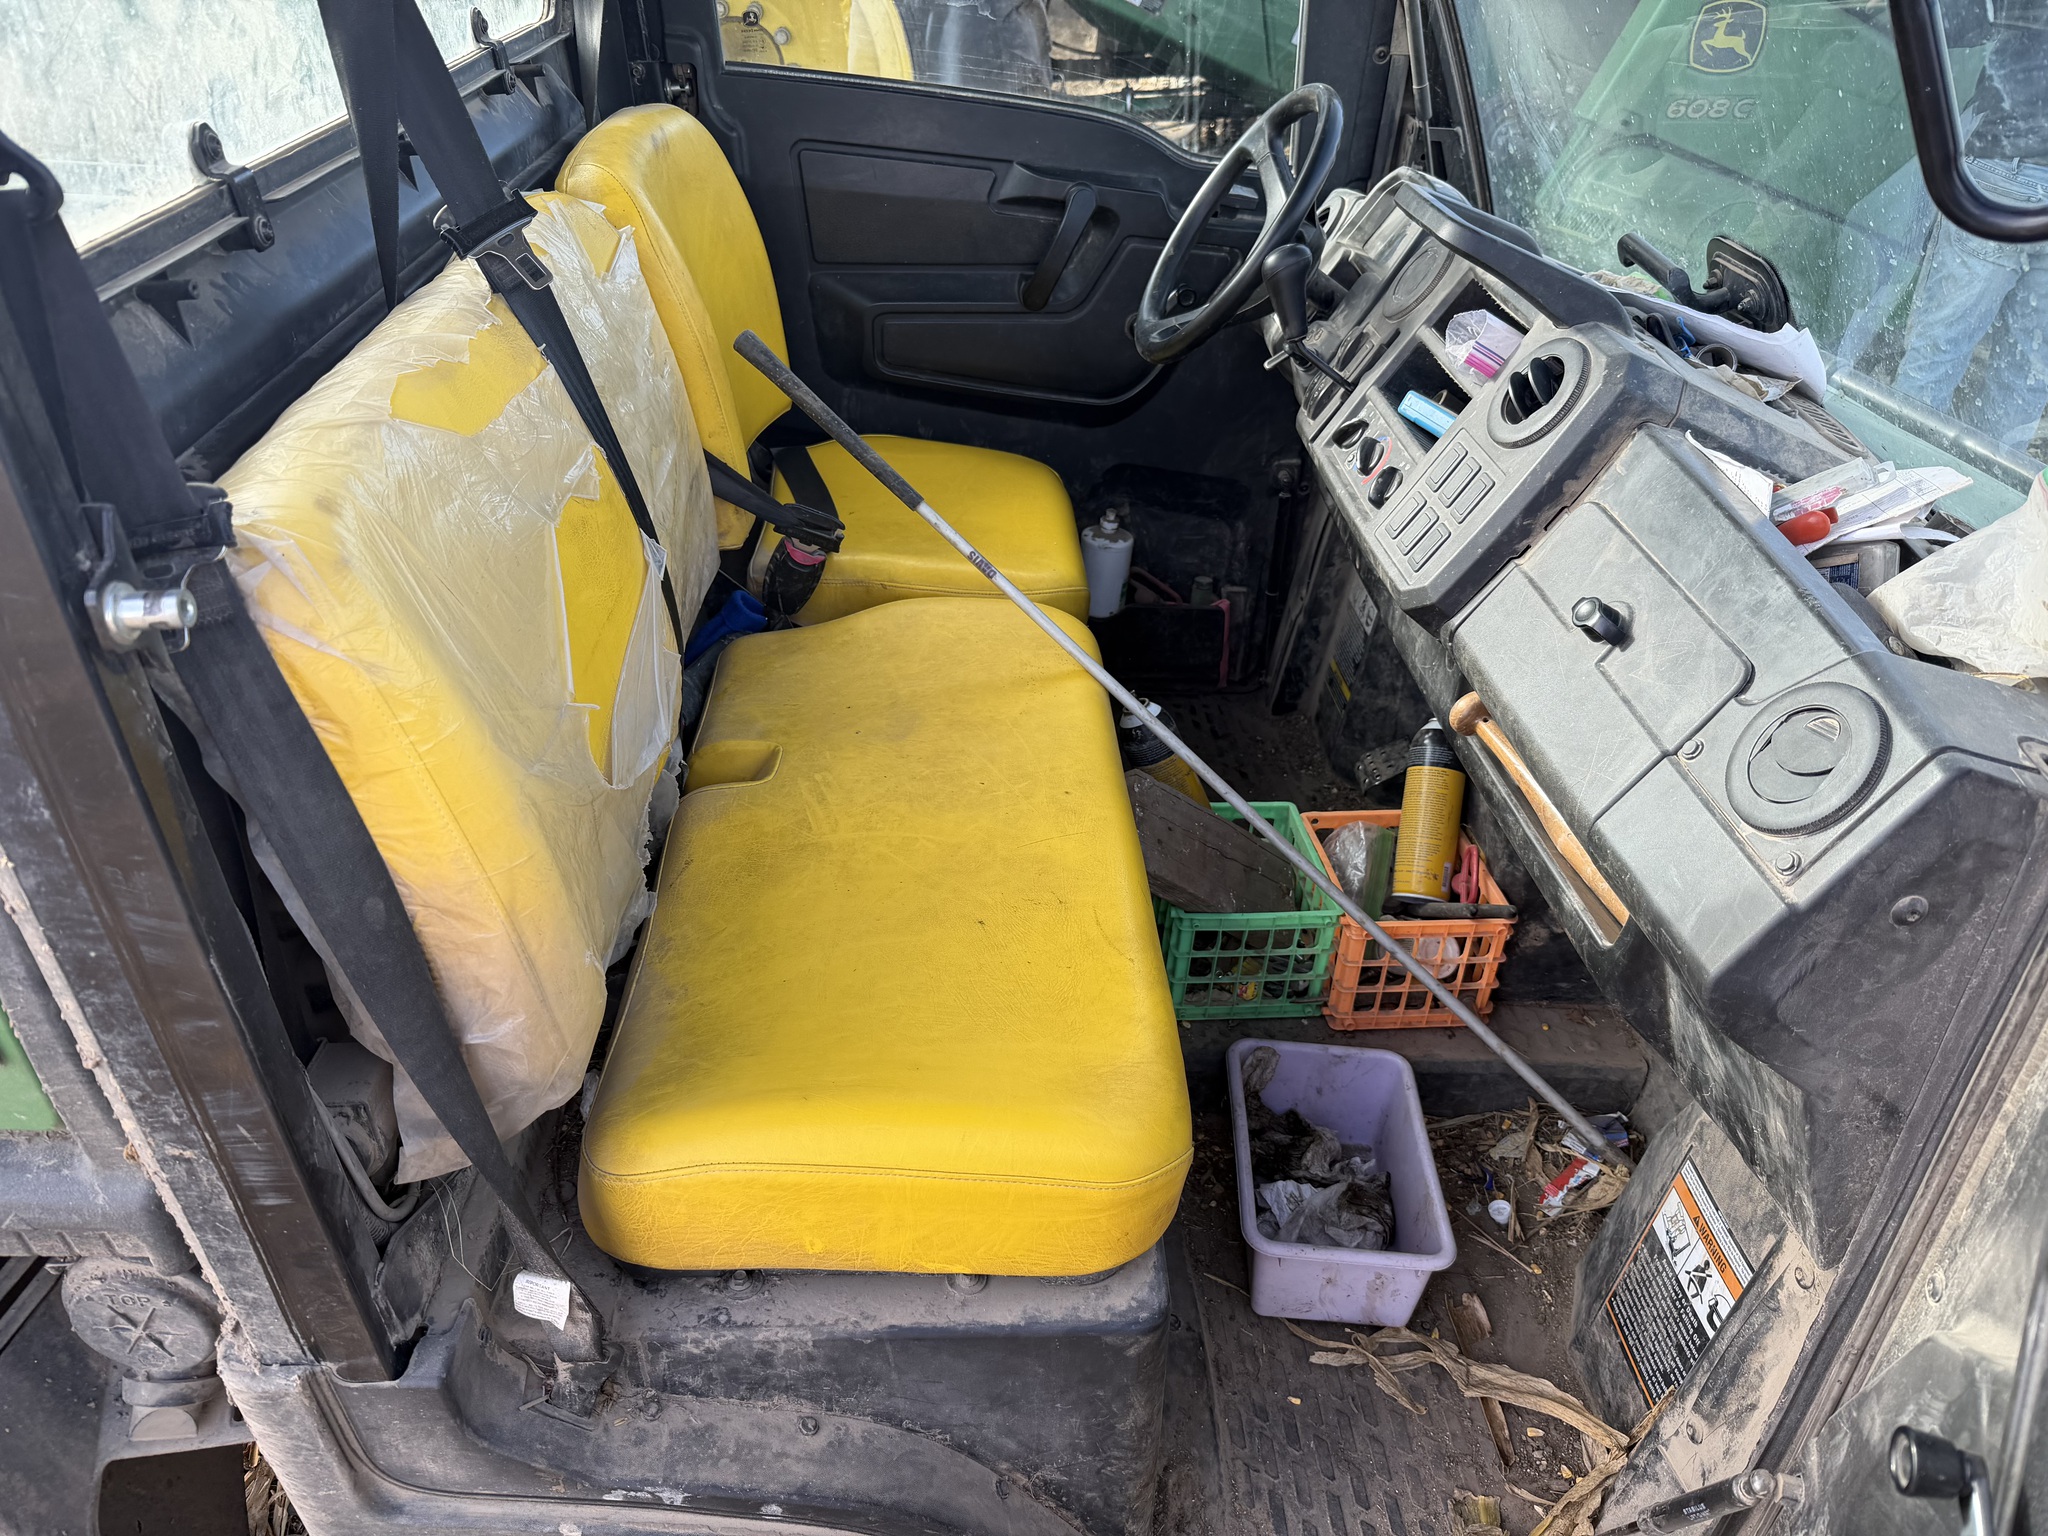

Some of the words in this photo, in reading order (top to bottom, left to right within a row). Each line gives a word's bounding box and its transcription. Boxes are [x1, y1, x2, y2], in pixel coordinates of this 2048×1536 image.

[967, 550, 998, 580] DAVIS
[1698, 1224, 1727, 1274] WARNING
[103, 1294, 152, 1307] TOP
